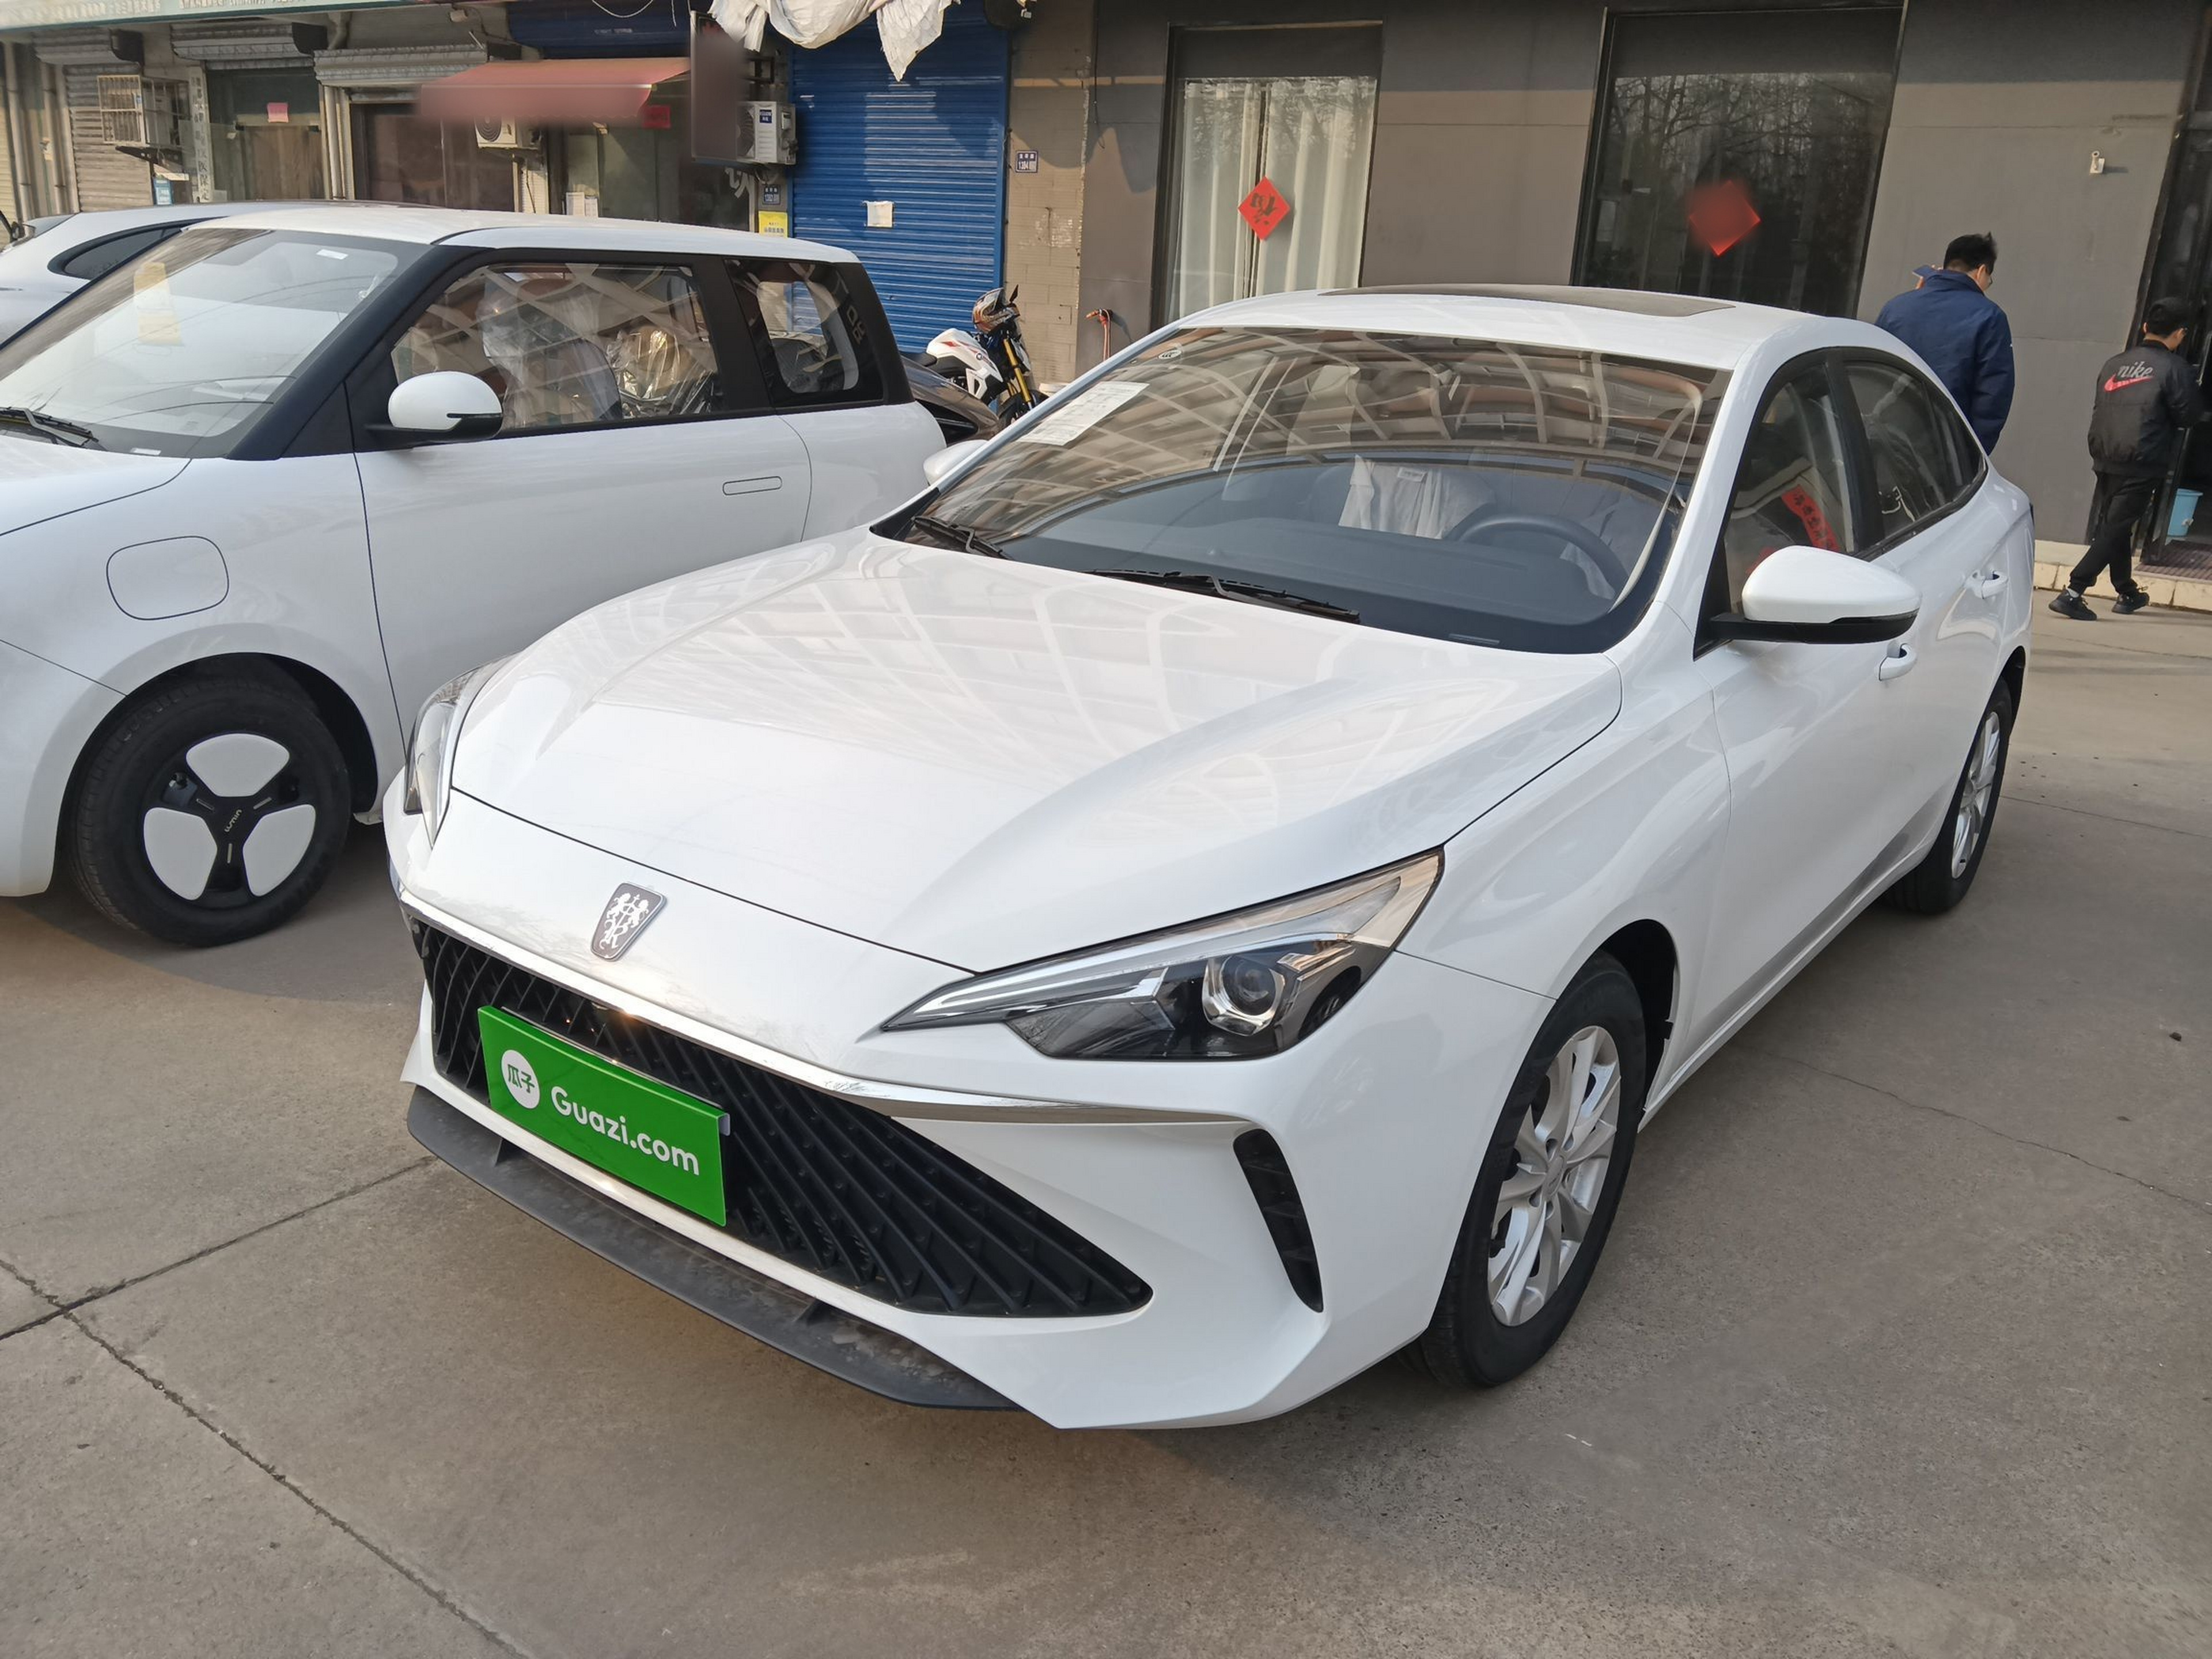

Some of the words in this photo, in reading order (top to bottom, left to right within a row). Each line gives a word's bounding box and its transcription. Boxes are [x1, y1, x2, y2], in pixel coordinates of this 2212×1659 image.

[2118, 361, 2153, 378] nike
[507, 1063, 535, 1094] 瓜子
[551, 1086, 699, 1176] Guazi.com
